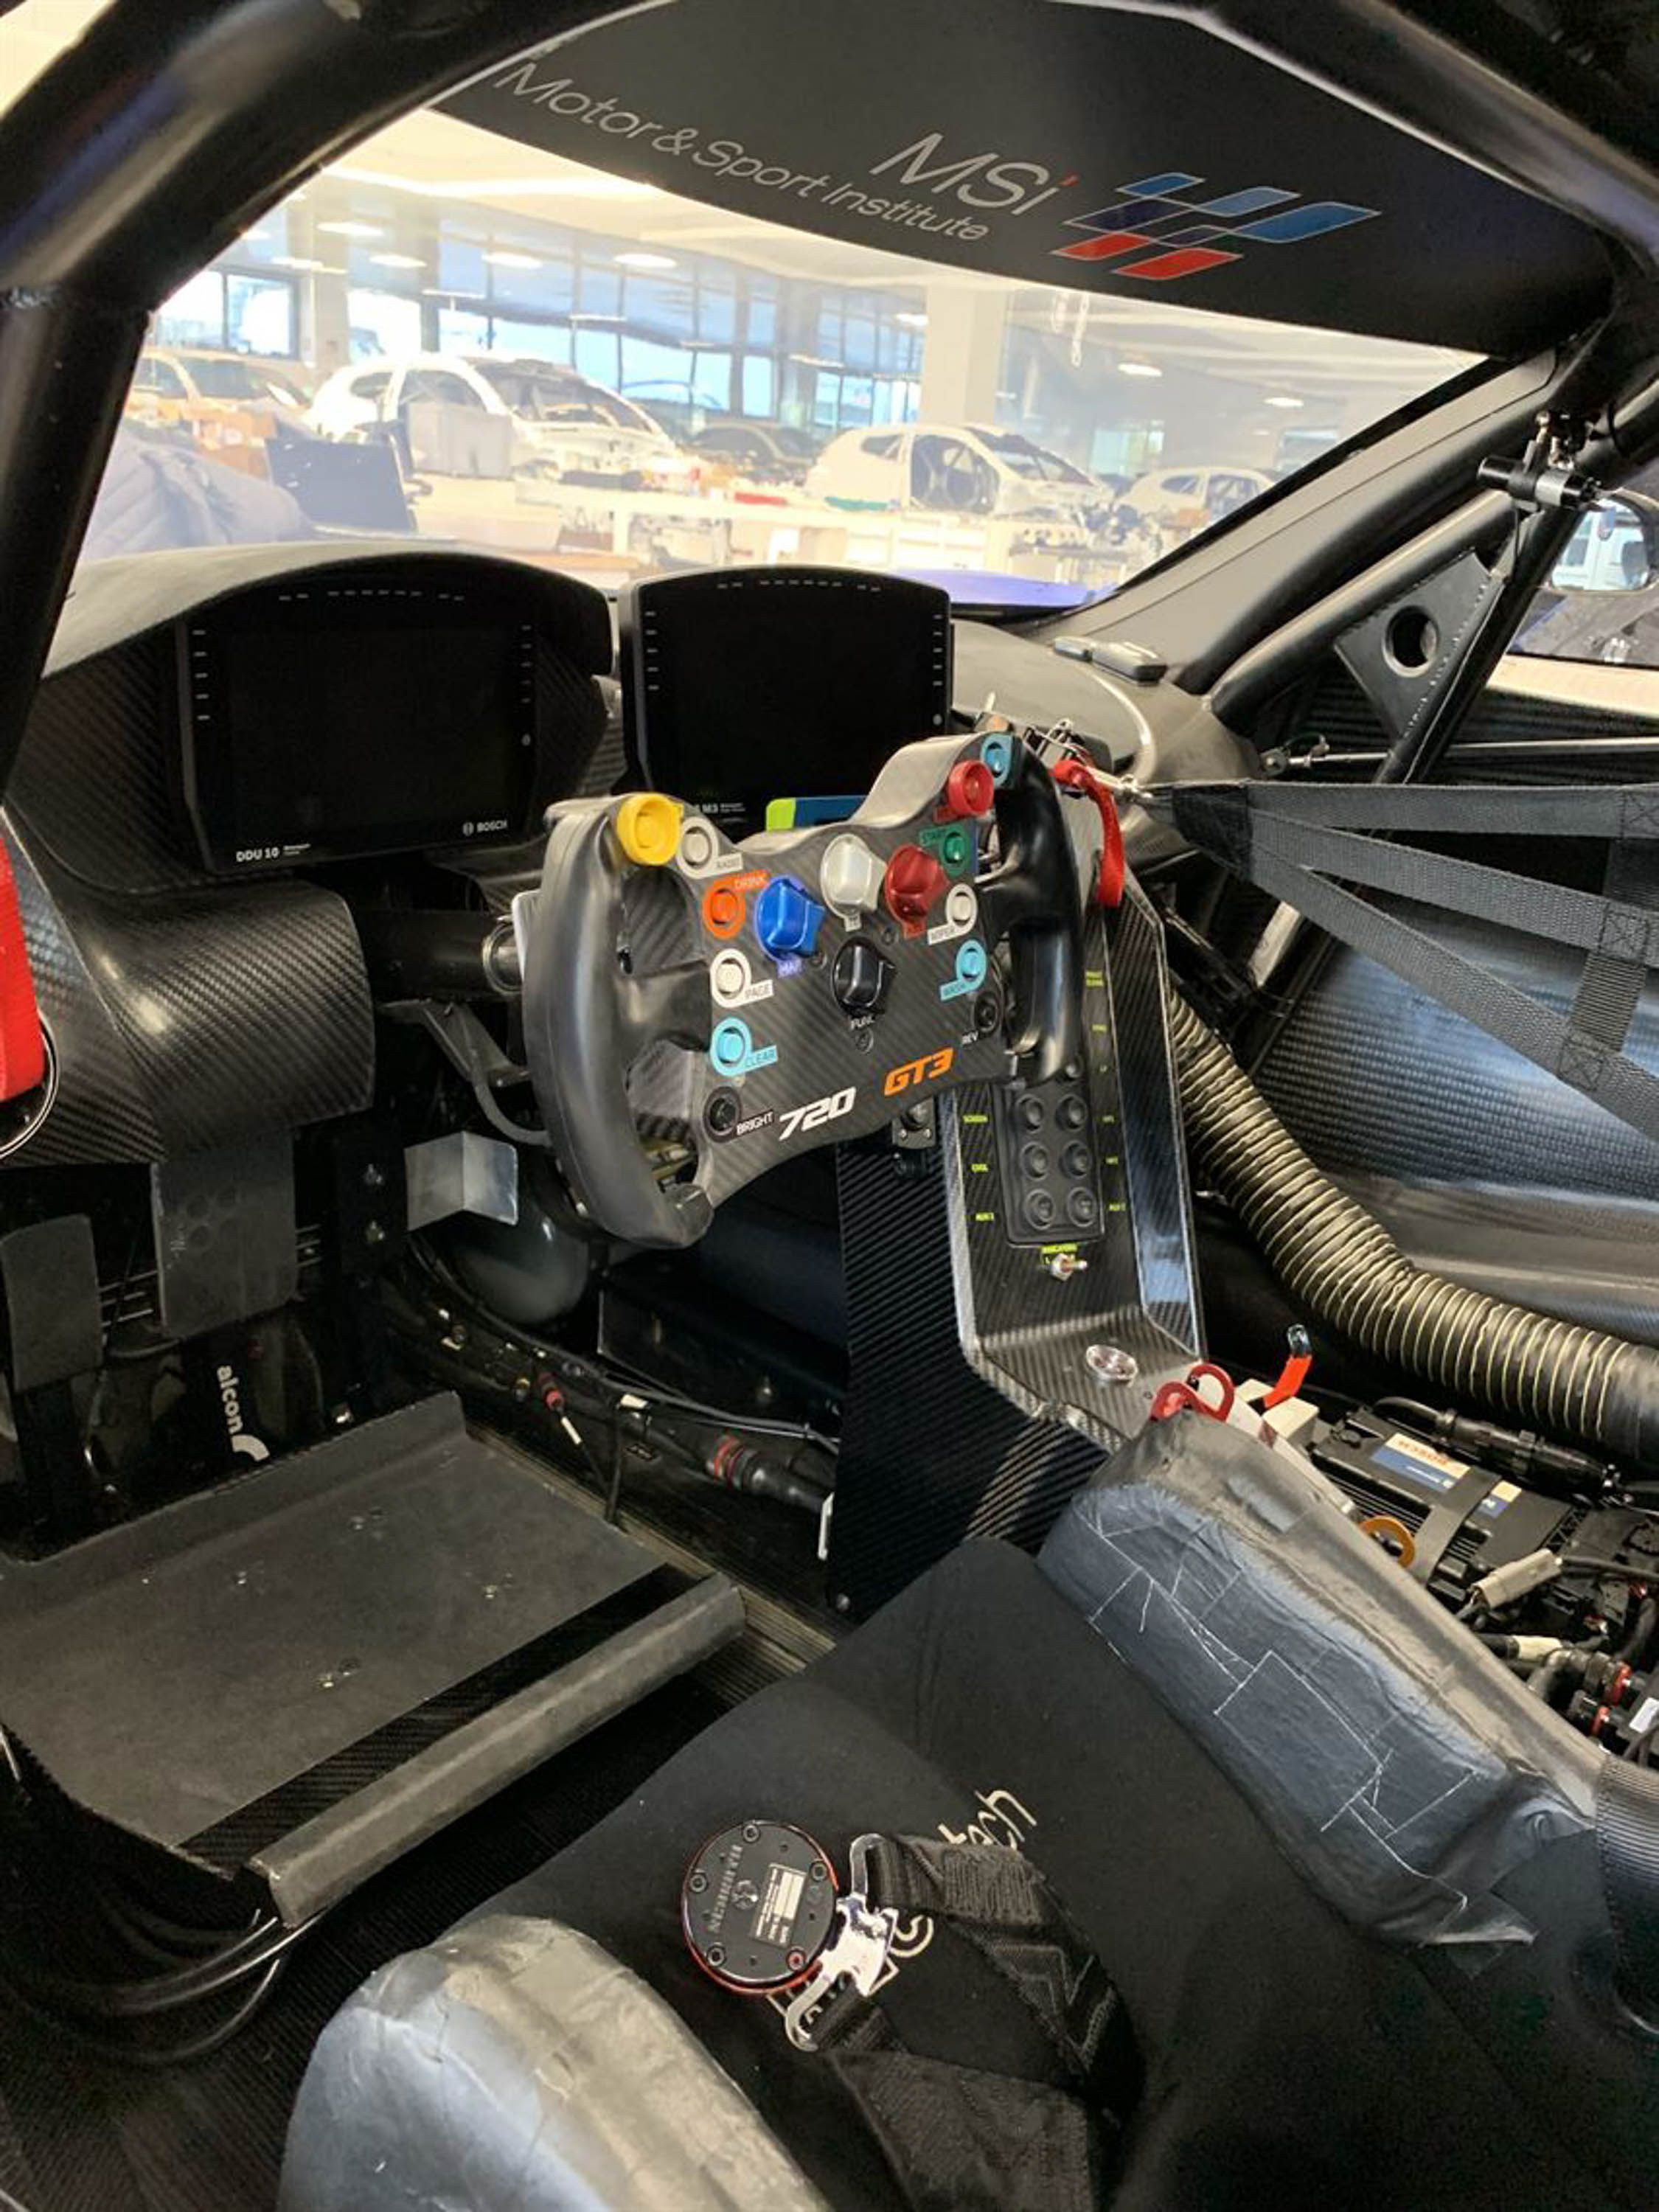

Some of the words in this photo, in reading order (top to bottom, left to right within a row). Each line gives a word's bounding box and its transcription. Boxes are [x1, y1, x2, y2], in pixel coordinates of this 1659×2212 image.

[493, 62, 663, 139] Motor
[692, 140, 830, 198] Sport
[820, 183, 990, 240] Institute
[869, 133, 1079, 215] MSi
[476, 818, 507, 833] BOSCH
[236, 848, 262, 863] DDU
[265, 846, 279, 860] 10
[745, 1048, 776, 1068] CLEAR
[779, 1086, 857, 1141] 720
[884, 1046, 954, 1096] GT3
[737, 1110, 774, 1135] BRIGHT
[217, 1366, 243, 1435] alcon
